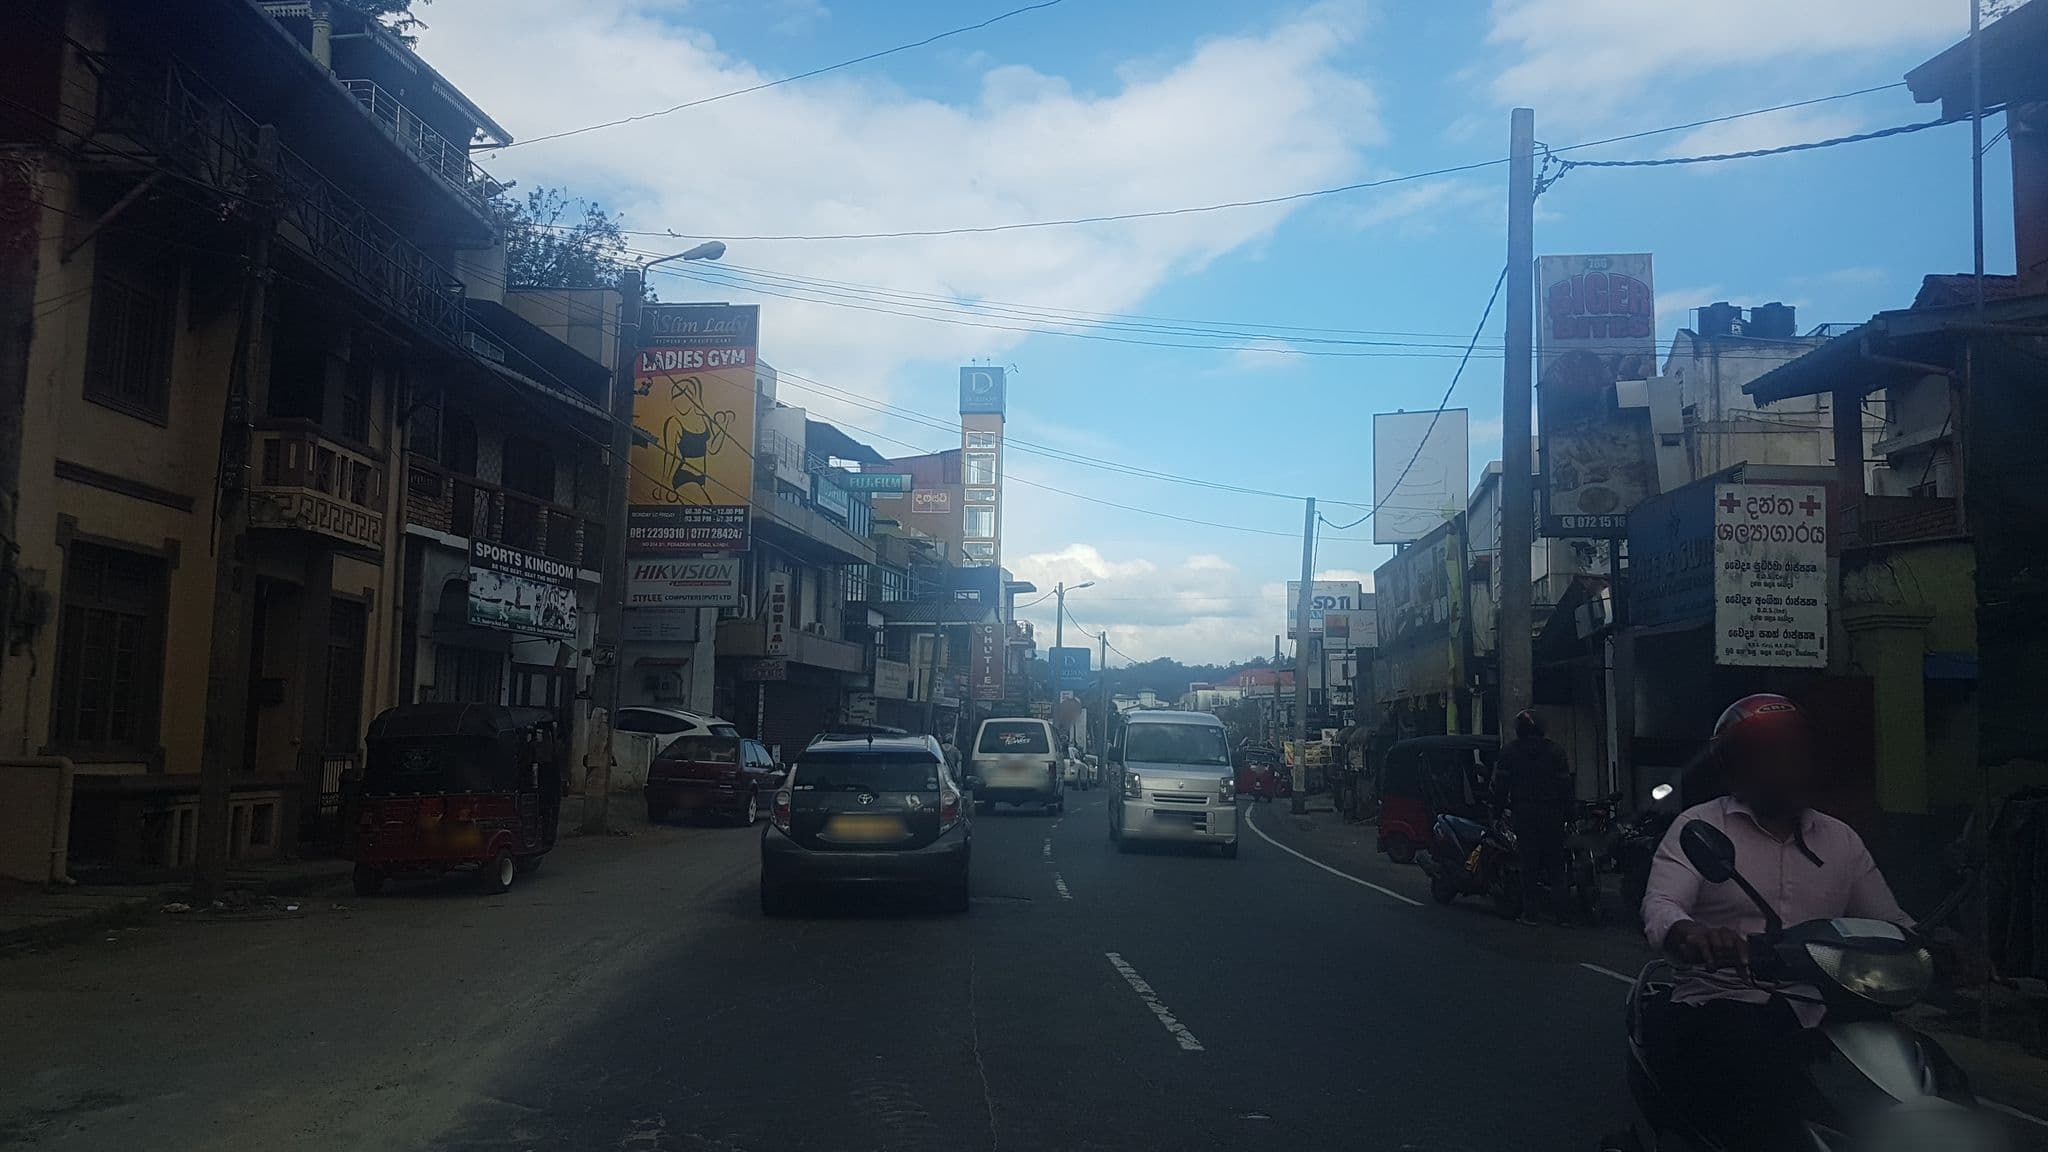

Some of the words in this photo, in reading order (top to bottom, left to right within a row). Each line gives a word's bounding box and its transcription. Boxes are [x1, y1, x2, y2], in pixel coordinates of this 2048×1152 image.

[642, 349, 705, 372] LADIES
[707, 348, 746, 367] GYM
[1578, 516, 1597, 528] 072
[1599, 516, 1611, 528] 15
[476, 541, 522, 567] SPORTS
[525, 555, 574, 580] KINGDOM
[634, 564, 732, 580] HIKVISION
[632, 594, 663, 602] STYLEE
